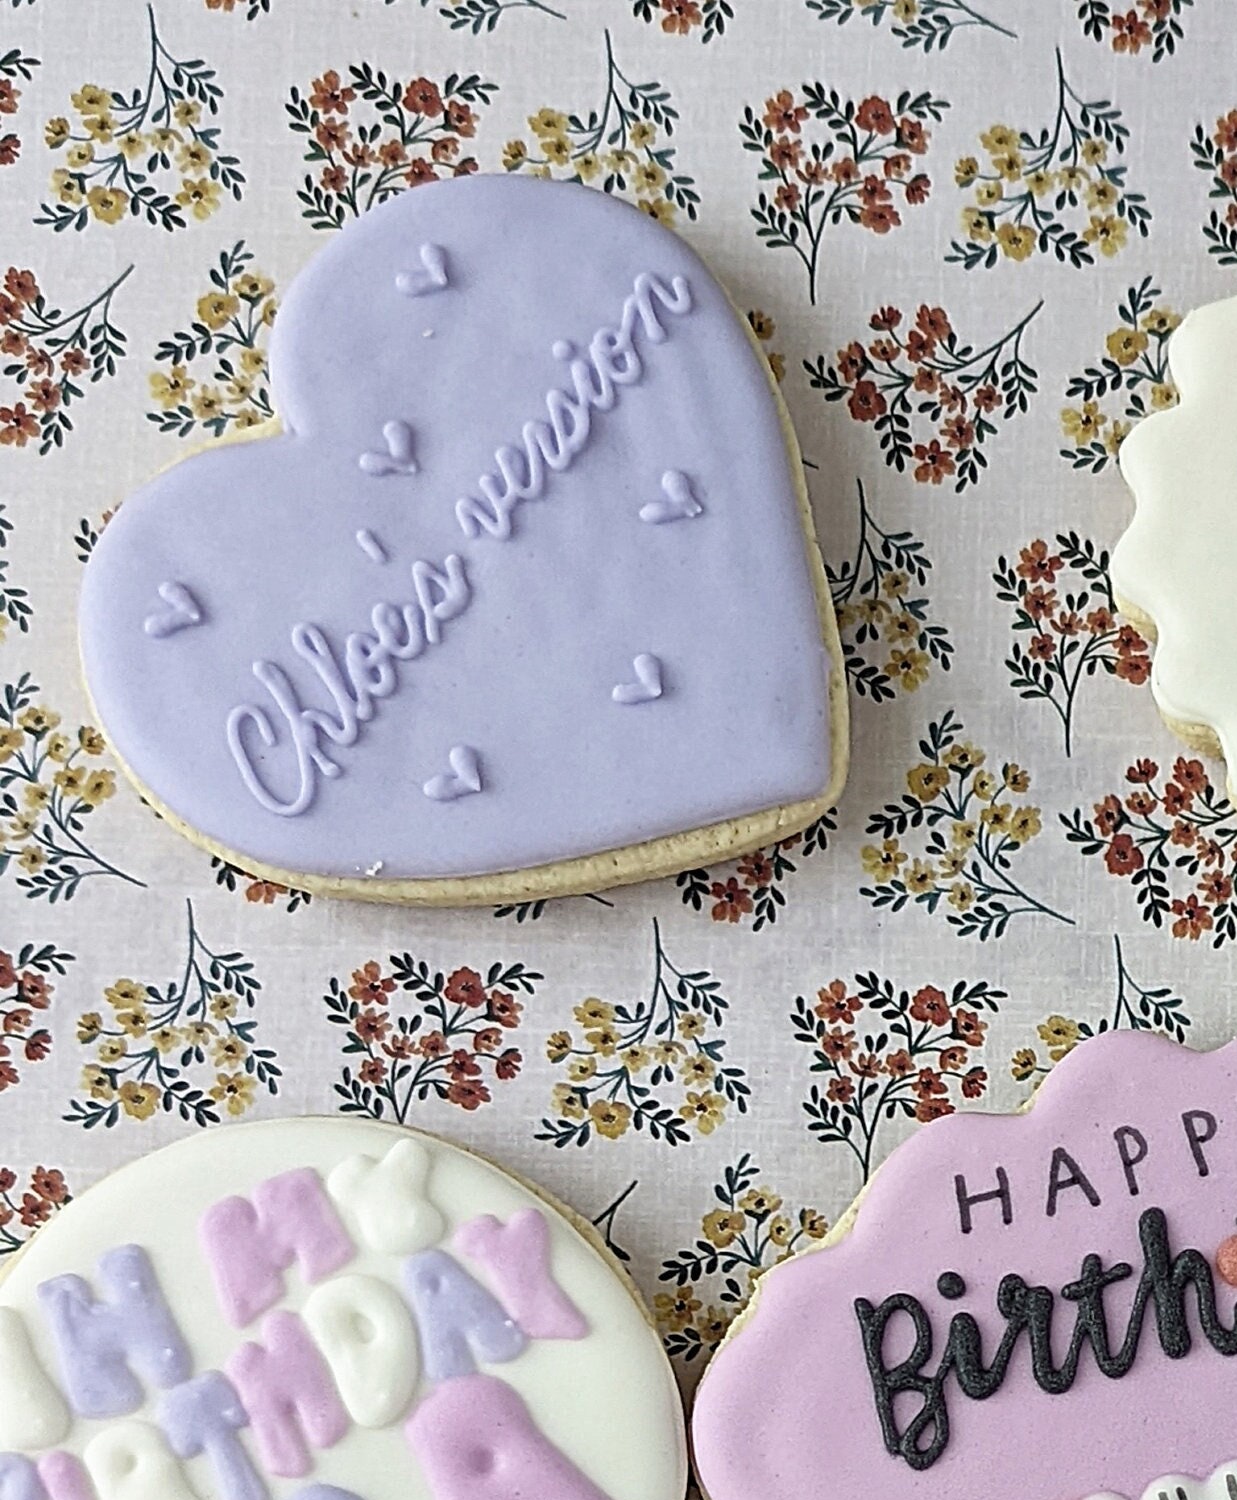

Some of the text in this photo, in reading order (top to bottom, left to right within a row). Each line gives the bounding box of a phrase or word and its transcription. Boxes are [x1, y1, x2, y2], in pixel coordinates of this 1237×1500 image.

[227, 271, 692, 816] Chloe's version
[198, 1138, 444, 1328] MY
